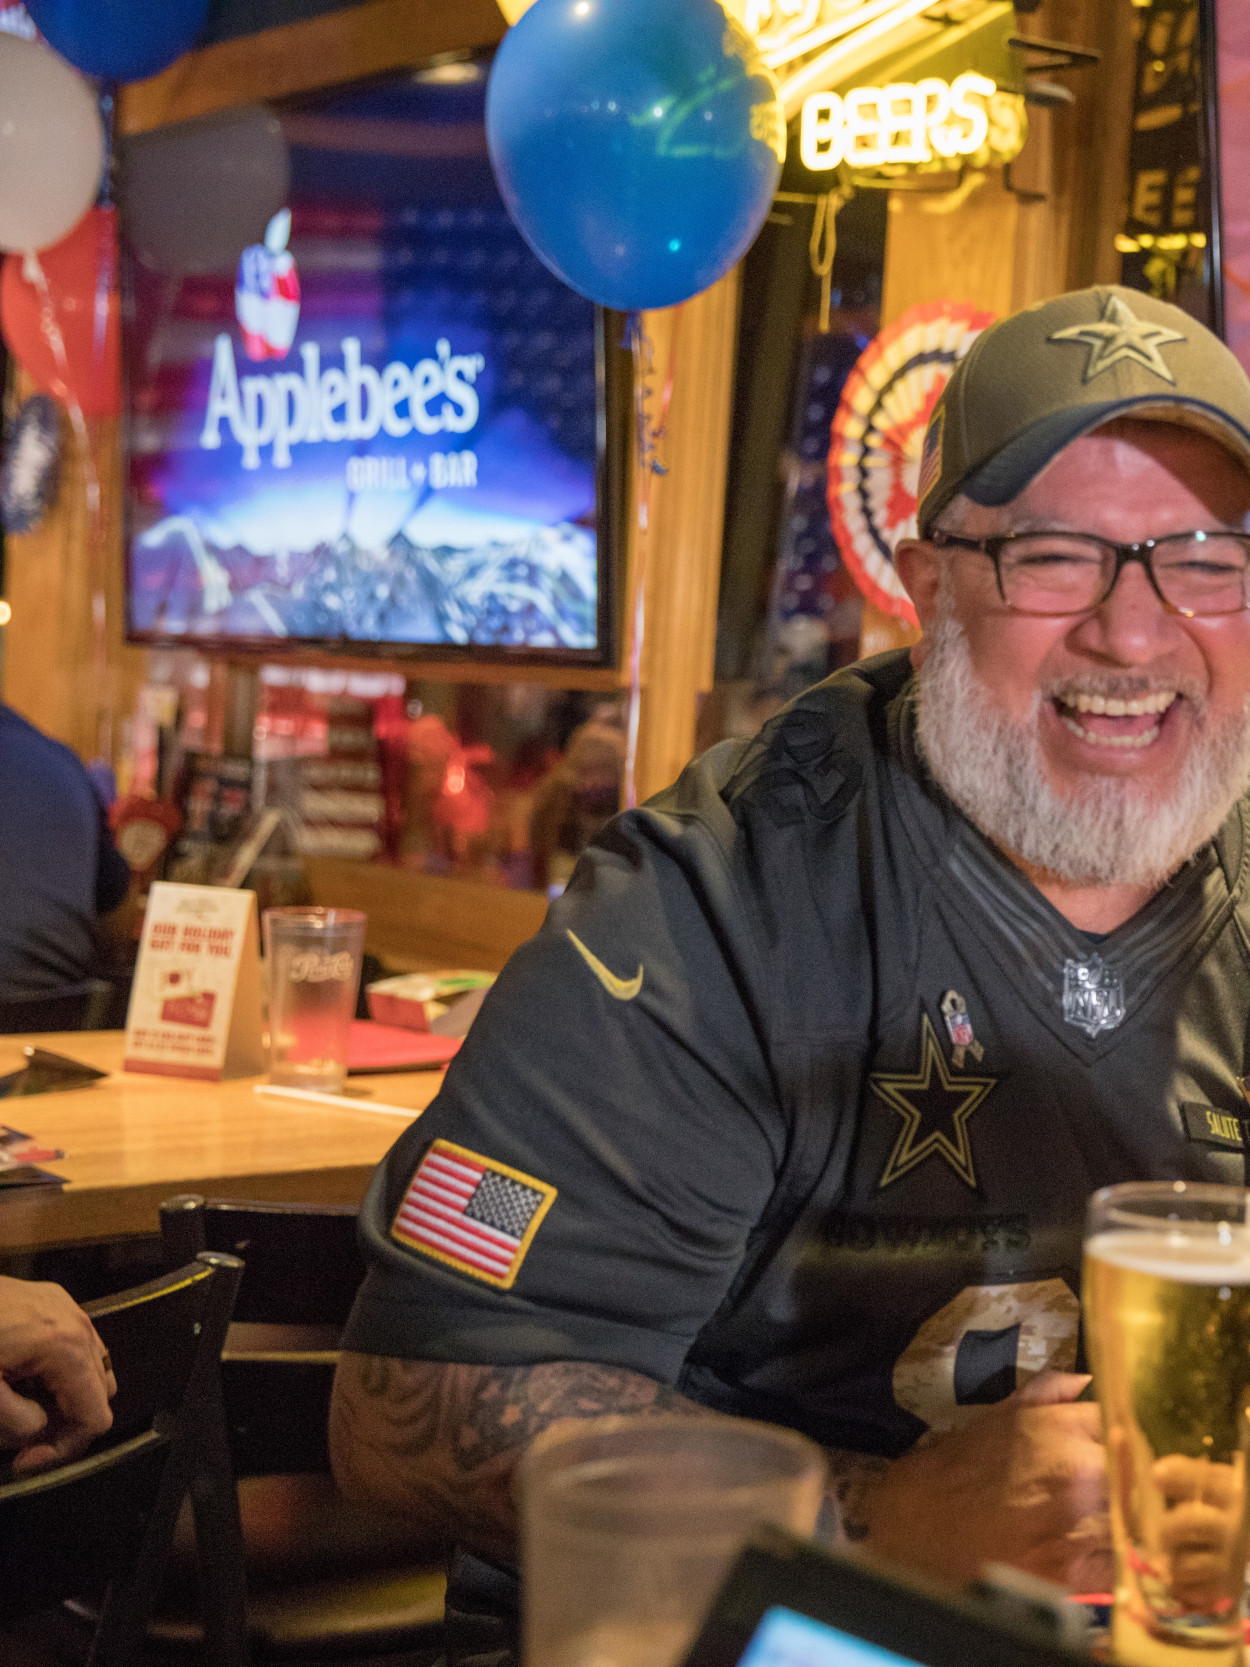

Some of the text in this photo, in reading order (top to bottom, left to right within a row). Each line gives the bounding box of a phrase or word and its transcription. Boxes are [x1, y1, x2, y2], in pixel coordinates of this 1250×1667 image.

[800, 72, 997, 170] BEERS
[200, 332, 480, 470] Applebee's
[1206, 1111, 1243, 1141] SALUTE
